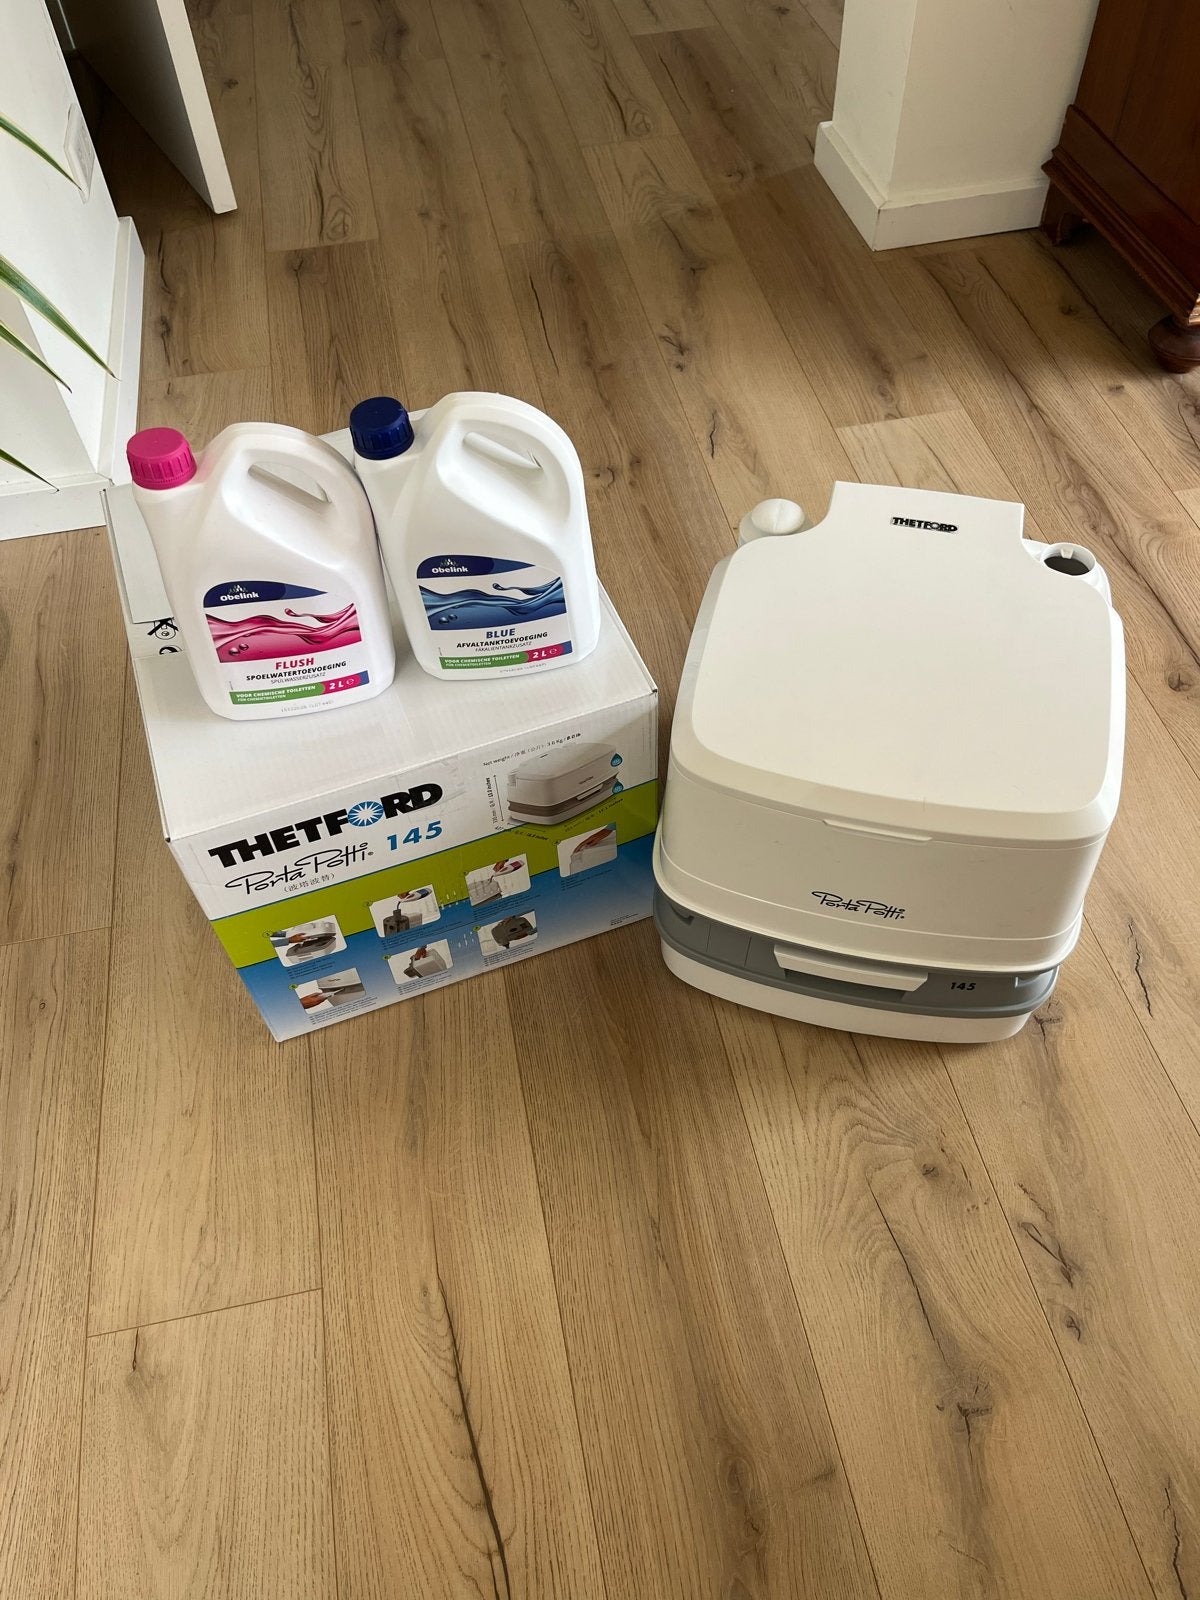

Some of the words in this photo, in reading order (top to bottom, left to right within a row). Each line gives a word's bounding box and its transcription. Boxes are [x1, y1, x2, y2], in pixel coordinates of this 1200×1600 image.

[892, 517, 958, 533] THETFORD
[431, 564, 469, 574] Obelink
[220, 591, 260, 602] Obelink
[485, 628, 516, 639] BLUE
[456, 631, 548, 649] AFVALTANKTOEVOEGING
[492, 654, 520, 662] TOILETTEN
[532, 651, 539, 659] 2
[541, 649, 547, 657] L
[275, 657, 315, 670] FLUSH
[246, 661, 347, 681] SPOELWATERTOEVOEGING
[253, 689, 286, 697] CHEMISCHE
[286, 685, 316, 694] TOILETTEN
[329, 682, 336, 690] 2
[338, 680, 344, 688] L
[207, 783, 444, 869] THETFORD
[225, 865, 306, 895] Porta
[294, 842, 369, 873] Potti
[386, 820, 443, 850] 145
[811, 891, 859, 912] Porta
[856, 900, 905, 920] Potti
[950, 981, 977, 991] 145
